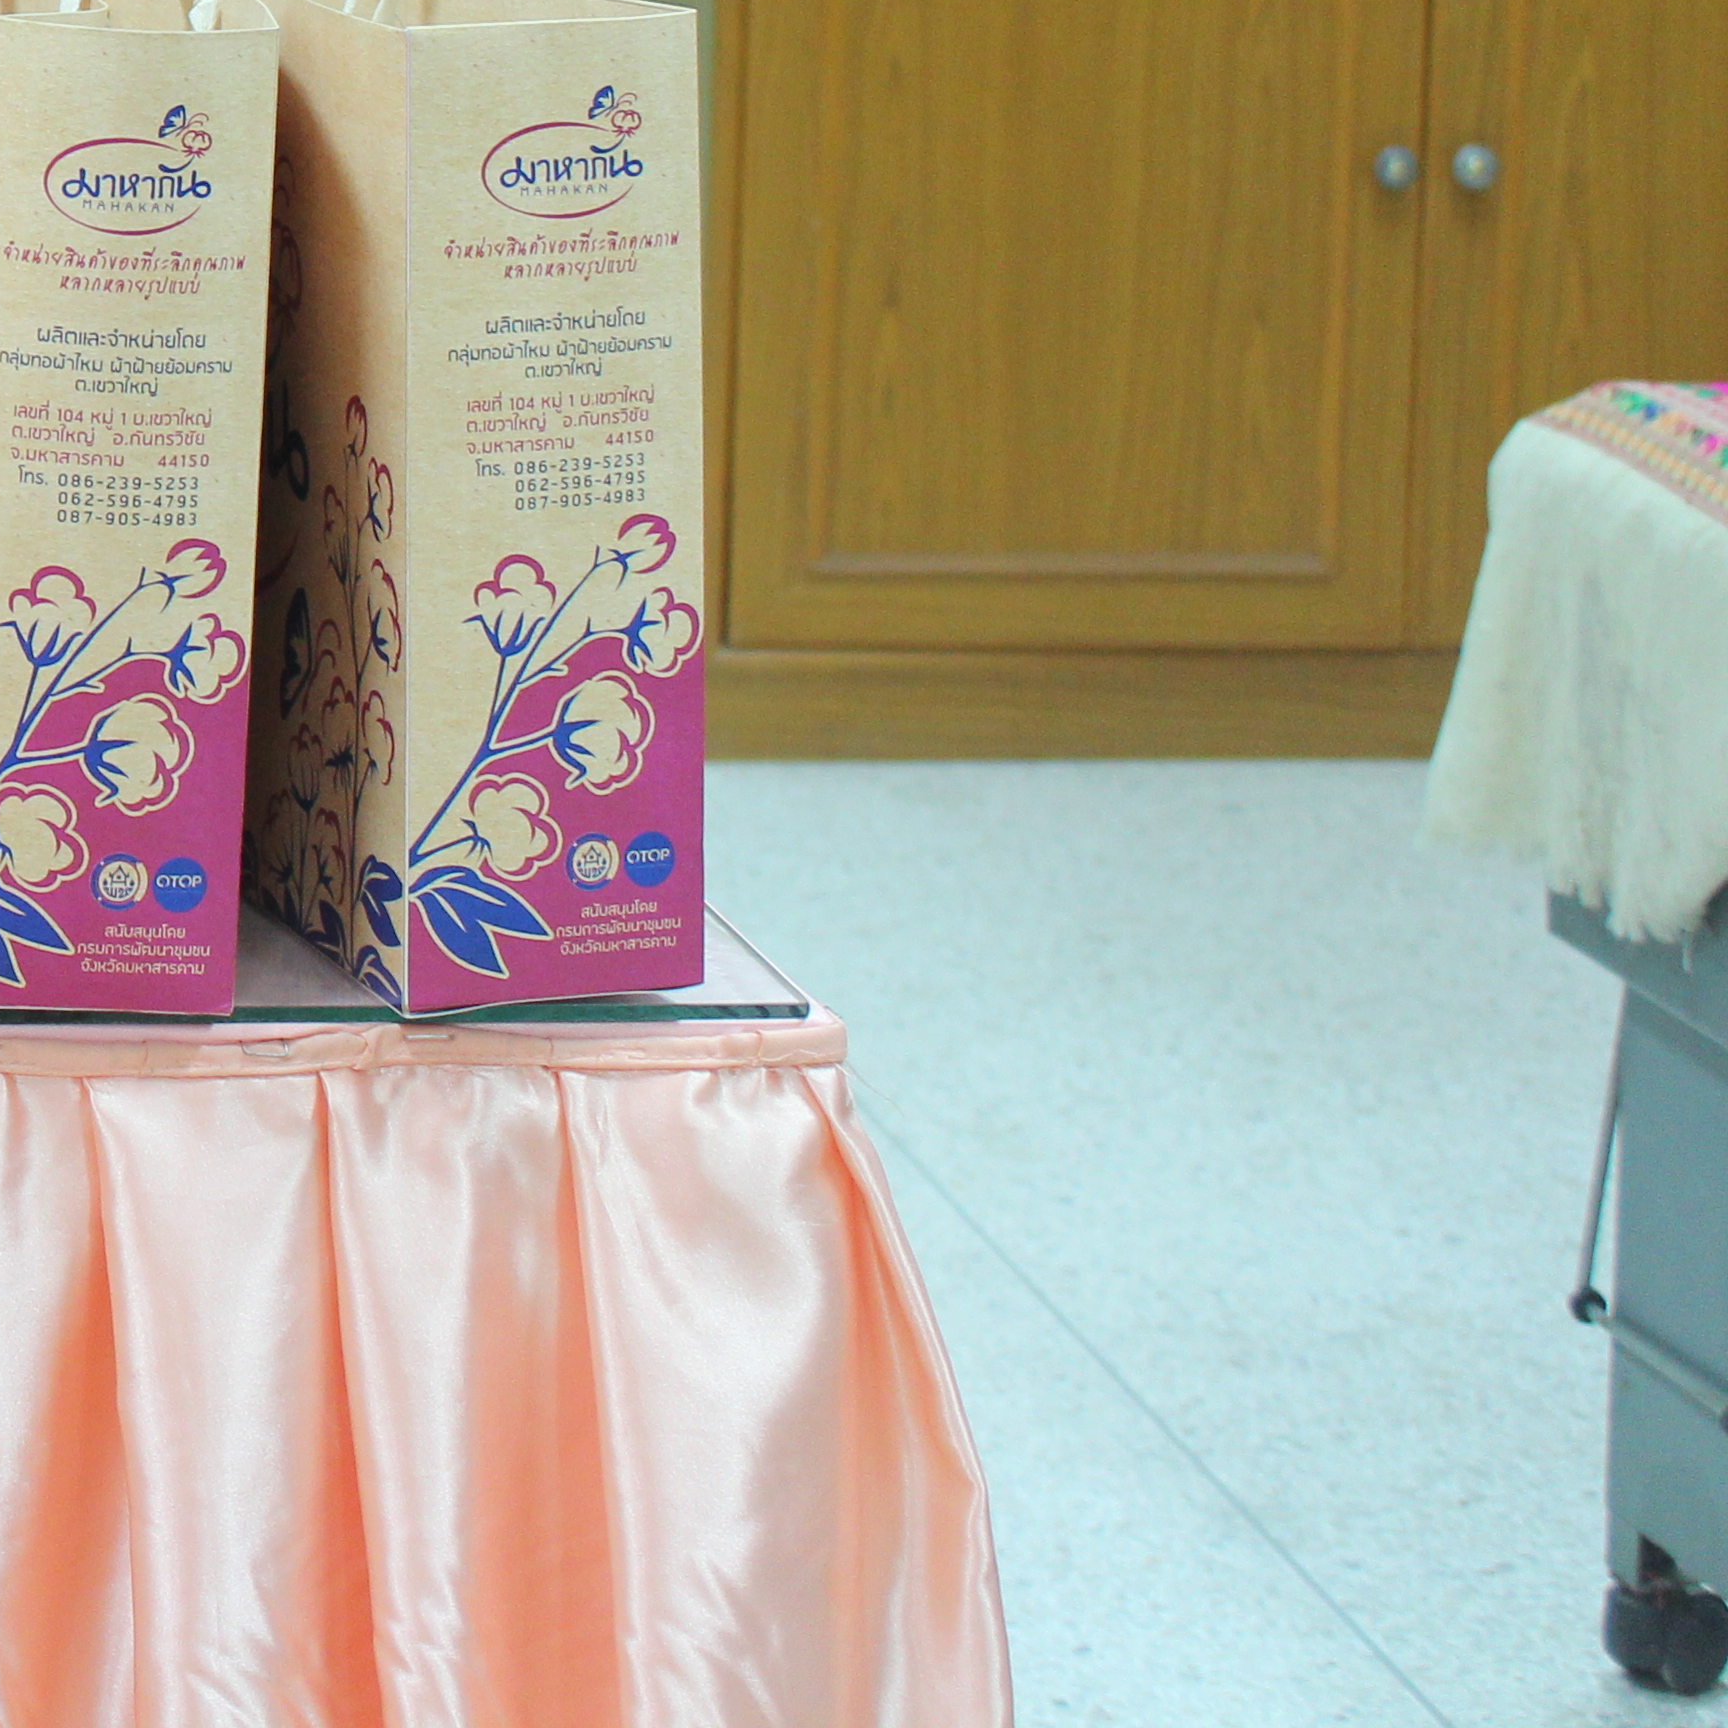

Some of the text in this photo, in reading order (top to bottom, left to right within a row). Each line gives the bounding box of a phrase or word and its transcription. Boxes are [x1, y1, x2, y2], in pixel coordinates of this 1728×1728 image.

[520, 183, 608, 197] MAHAKAN
[82, 199, 175, 213] MAHAKAN
[485, 306, 646, 335] ผลิตและจำหน่ายโดย
[37, 326, 206, 349] ผลิตและจำหน่ายโดย
[524, 356, 602, 379] ต.เขวาใหญ่
[75, 375, 158, 397] ต.เขวาใหญ่
[466, 392, 502, 413] เลขที่
[509, 396, 534, 411] 104
[541, 391, 562, 414] หมู่
[580, 384, 655, 407] บ.เขวาใหญ่
[14, 400, 50, 420] เลขที่
[58, 408, 83, 423] 104
[91, 408, 113, 430] หมู่
[133, 408, 212, 428] บ.เขวาใหญ่
[466, 407, 649, 434] ต.เขวาใหญ่ อ.กันทรวิชัย
[12, 424, 204, 446] ต.เขวาใหญ่ อ.กันทรวิชัย
[466, 429, 654, 455] จ.มหาสารคาม 44150
[11, 446, 209, 468] จ.มหาสารคาม 44150
[476, 452, 645, 477] โทร. 086-239-5253
[18, 465, 199, 490] โทร. 086-239-5253
[515, 470, 646, 493] 062-596-4795
[58, 492, 198, 508] 062-596-4795
[515, 488, 646, 511] 087-905-4983
[57, 510, 197, 526] 087-905-4983
[626, 848, 670, 864] OTOP
[156, 874, 202, 888] OTOP
[581, 899, 657, 920] สนับสนุนโดย
[105, 923, 185, 942] สนับสนุนโดย
